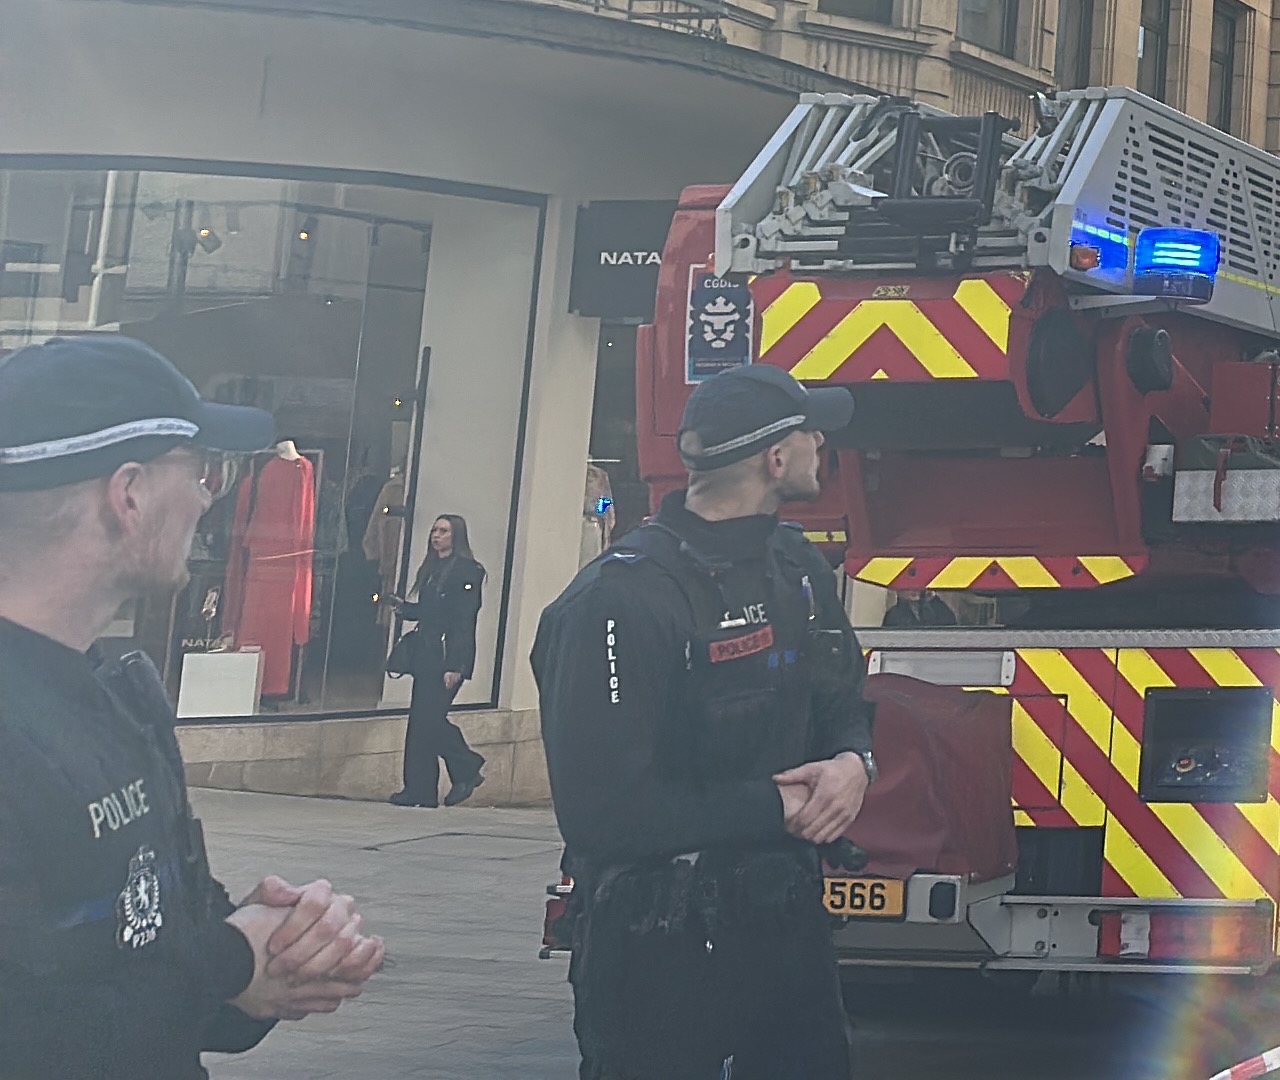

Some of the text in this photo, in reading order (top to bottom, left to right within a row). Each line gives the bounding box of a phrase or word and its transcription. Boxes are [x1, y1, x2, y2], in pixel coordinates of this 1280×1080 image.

[601, 252, 661, 264] NATA
[704, 278, 740, 288] CGD
[606, 620, 620, 704] POLICE
[88, 779, 150, 838] POLICE
